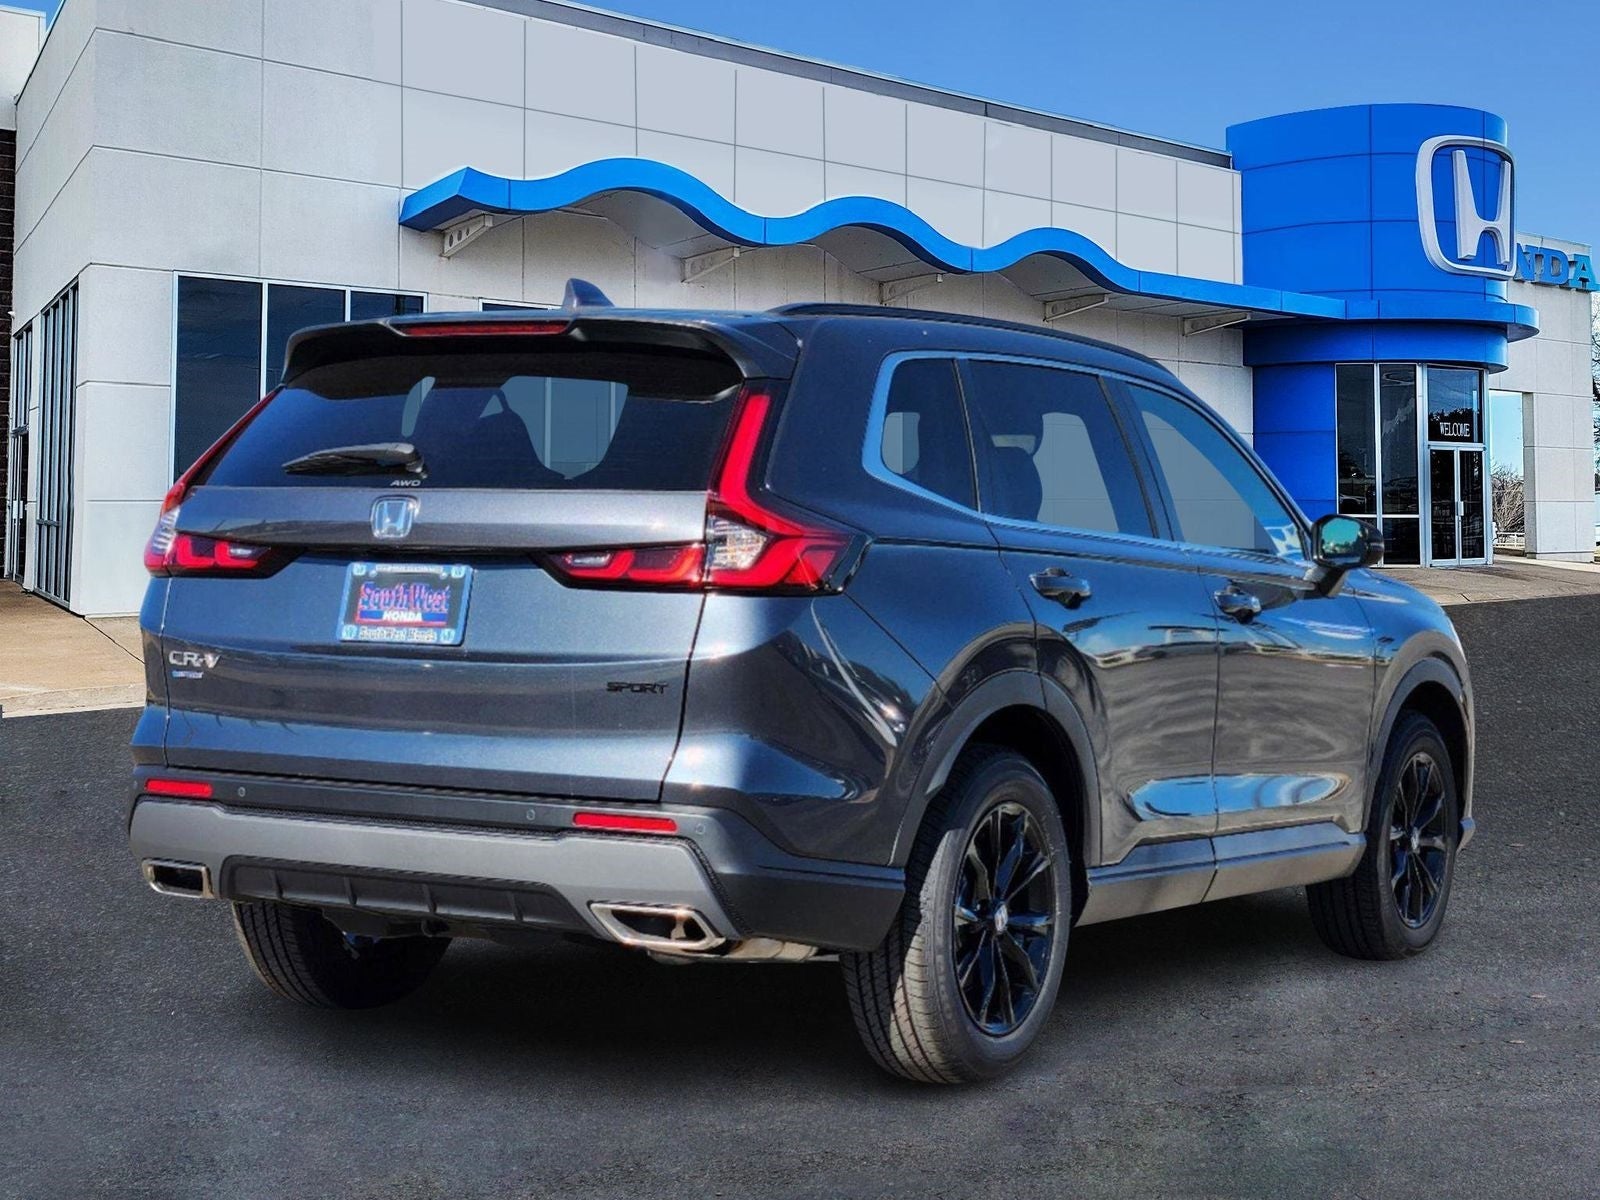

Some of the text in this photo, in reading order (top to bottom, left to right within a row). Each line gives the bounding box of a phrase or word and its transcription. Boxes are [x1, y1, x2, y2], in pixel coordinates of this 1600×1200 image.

[1439, 421, 1471, 437] WELCOME
[389, 479, 421, 487] AWD
[381, 610, 424, 623] HONDA
[168, 650, 221, 669] CR-V
[606, 681, 669, 695] SPORT
